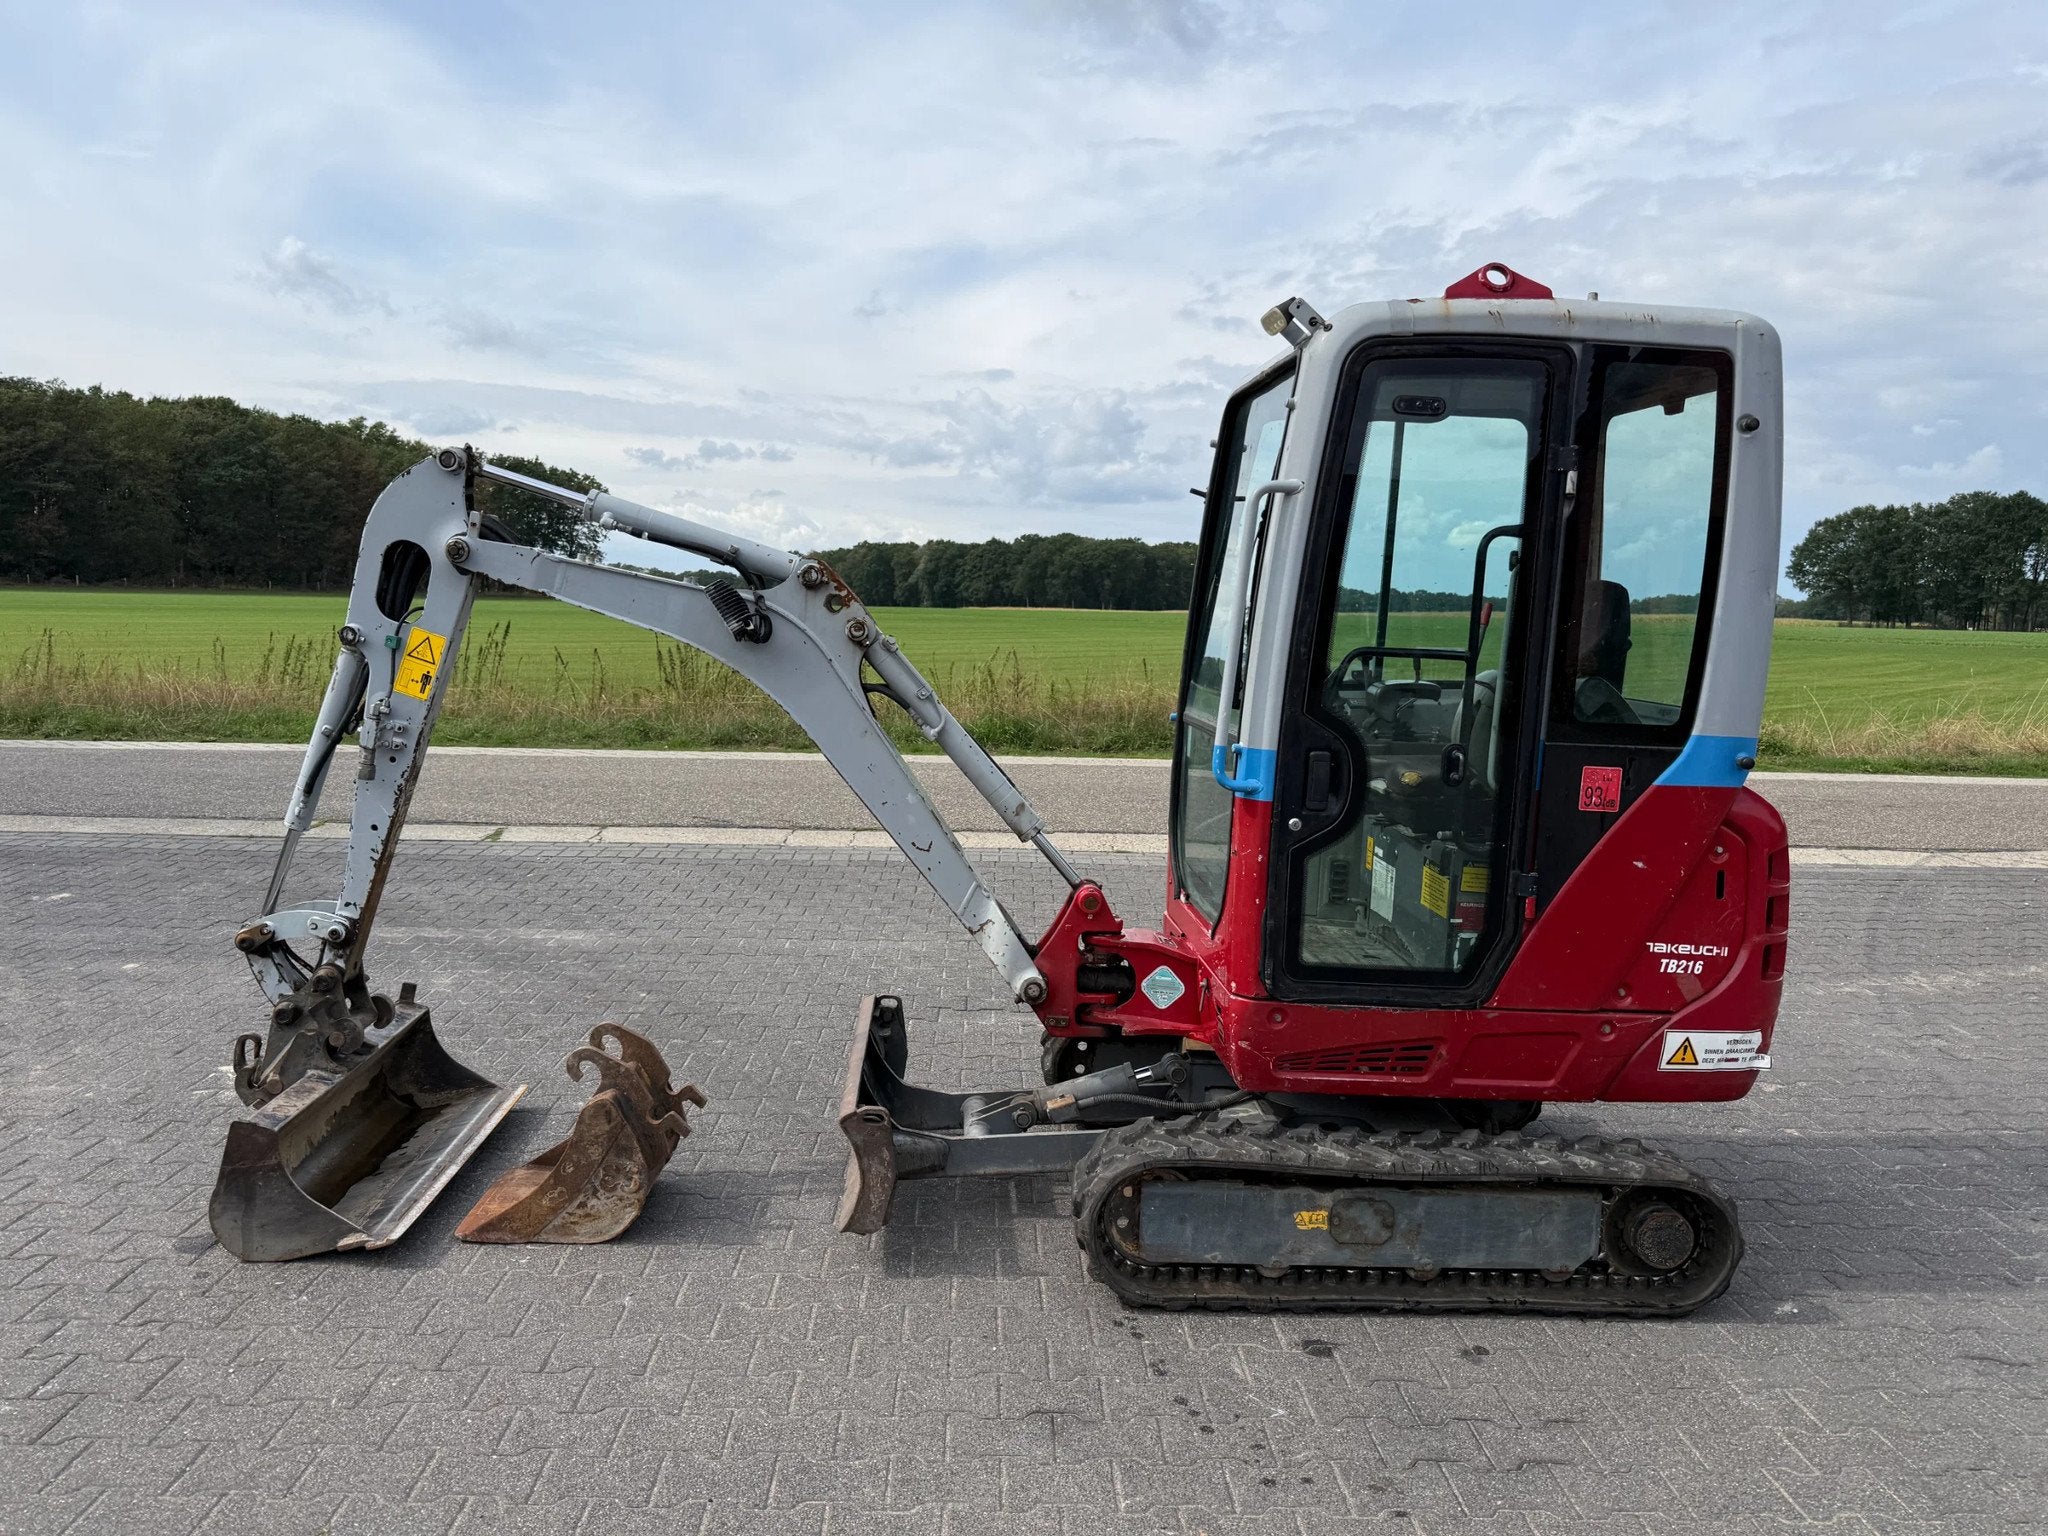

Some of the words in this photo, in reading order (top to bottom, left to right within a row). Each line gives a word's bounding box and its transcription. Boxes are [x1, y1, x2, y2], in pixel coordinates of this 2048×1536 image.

[1584, 786, 1602, 807] 93
[1646, 942, 1729, 957] TAKEUCHI
[1659, 958, 1704, 974] TB216
